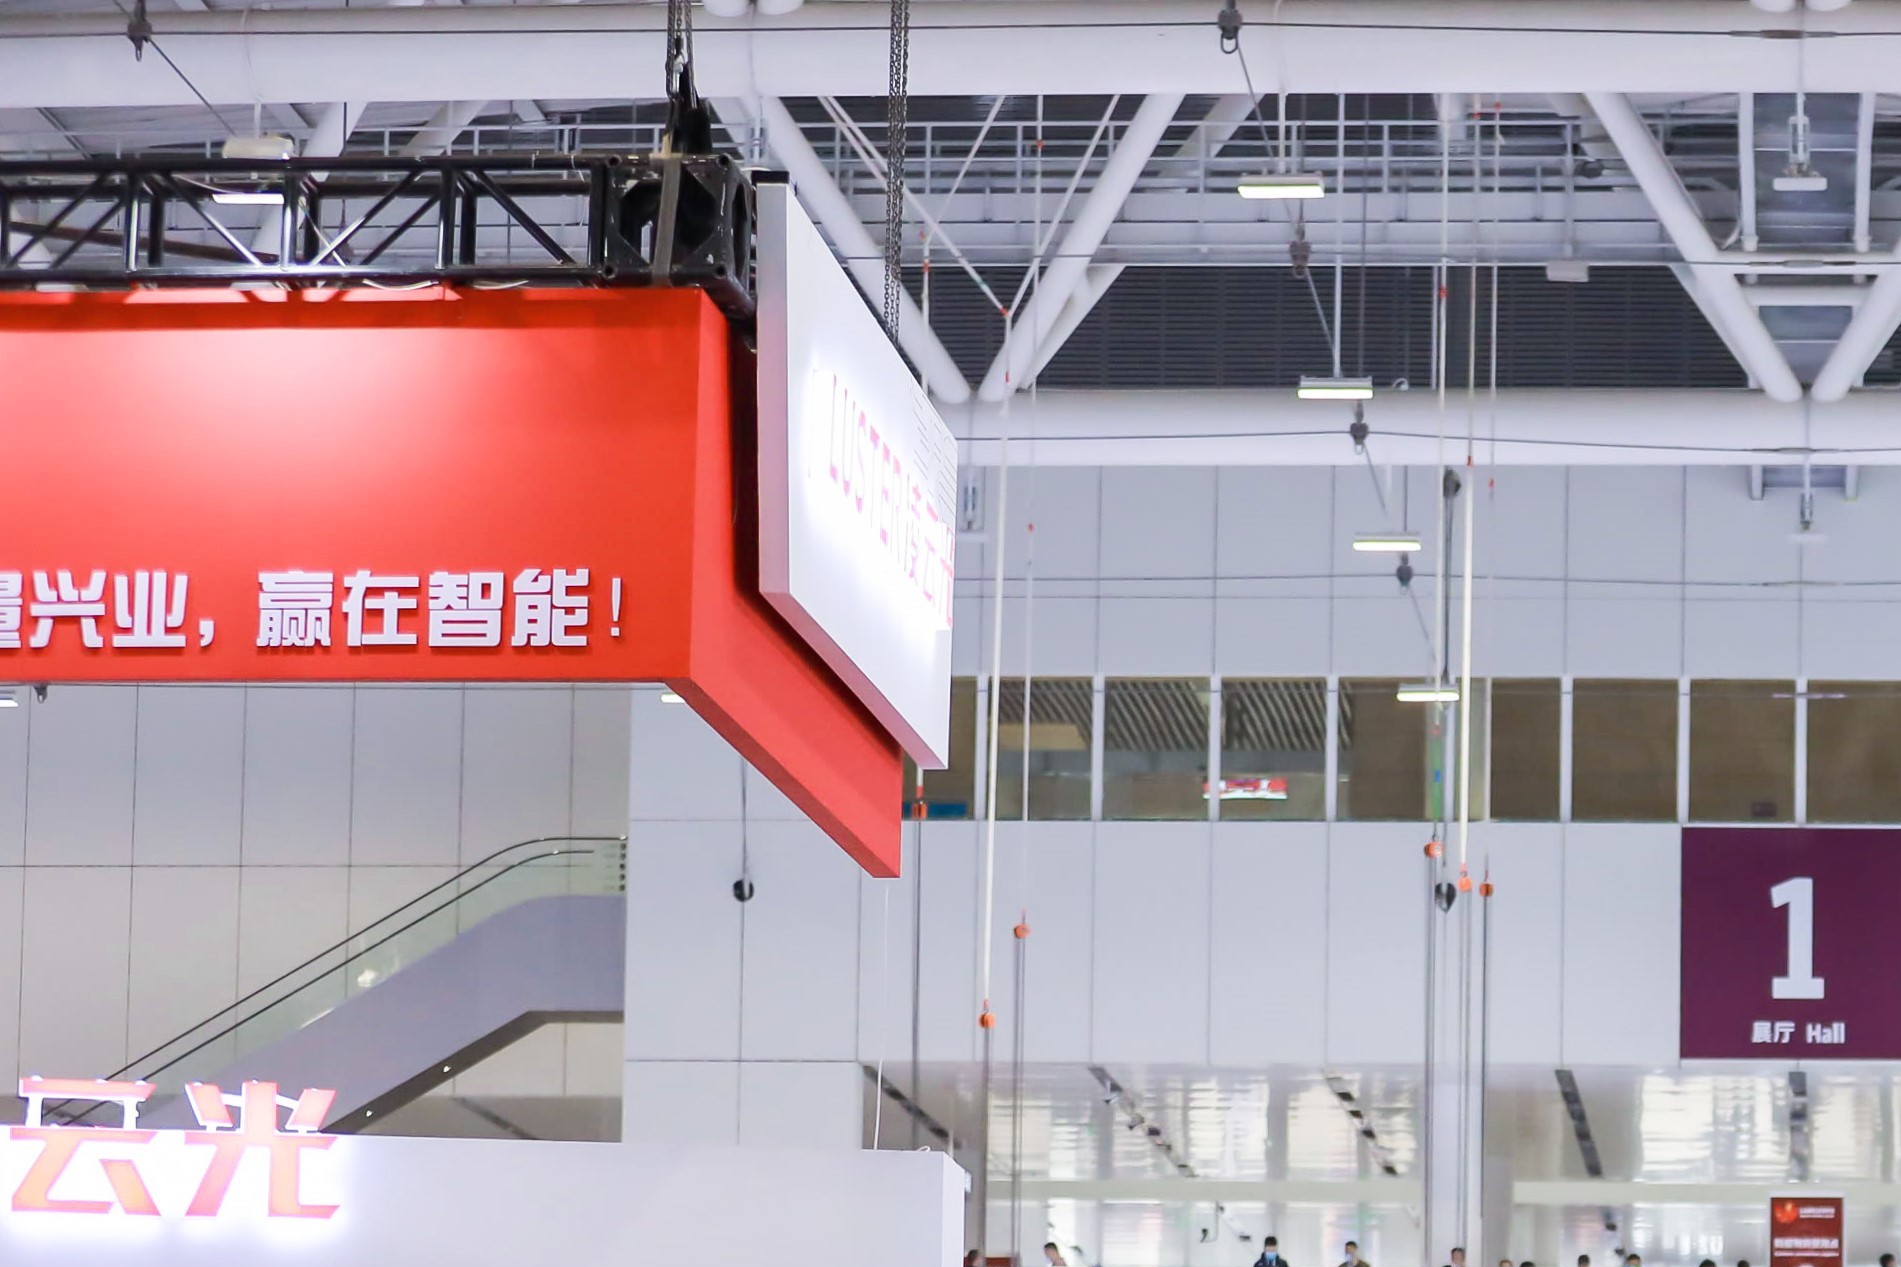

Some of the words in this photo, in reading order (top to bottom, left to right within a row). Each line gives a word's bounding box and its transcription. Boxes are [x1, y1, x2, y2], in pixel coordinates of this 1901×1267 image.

[1770, 876, 1825, 1000] 1
[1752, 1021, 1795, 1043] 展厅
[1806, 1021, 1845, 1044] Hall
[10, 1075, 342, 1220] 云光
